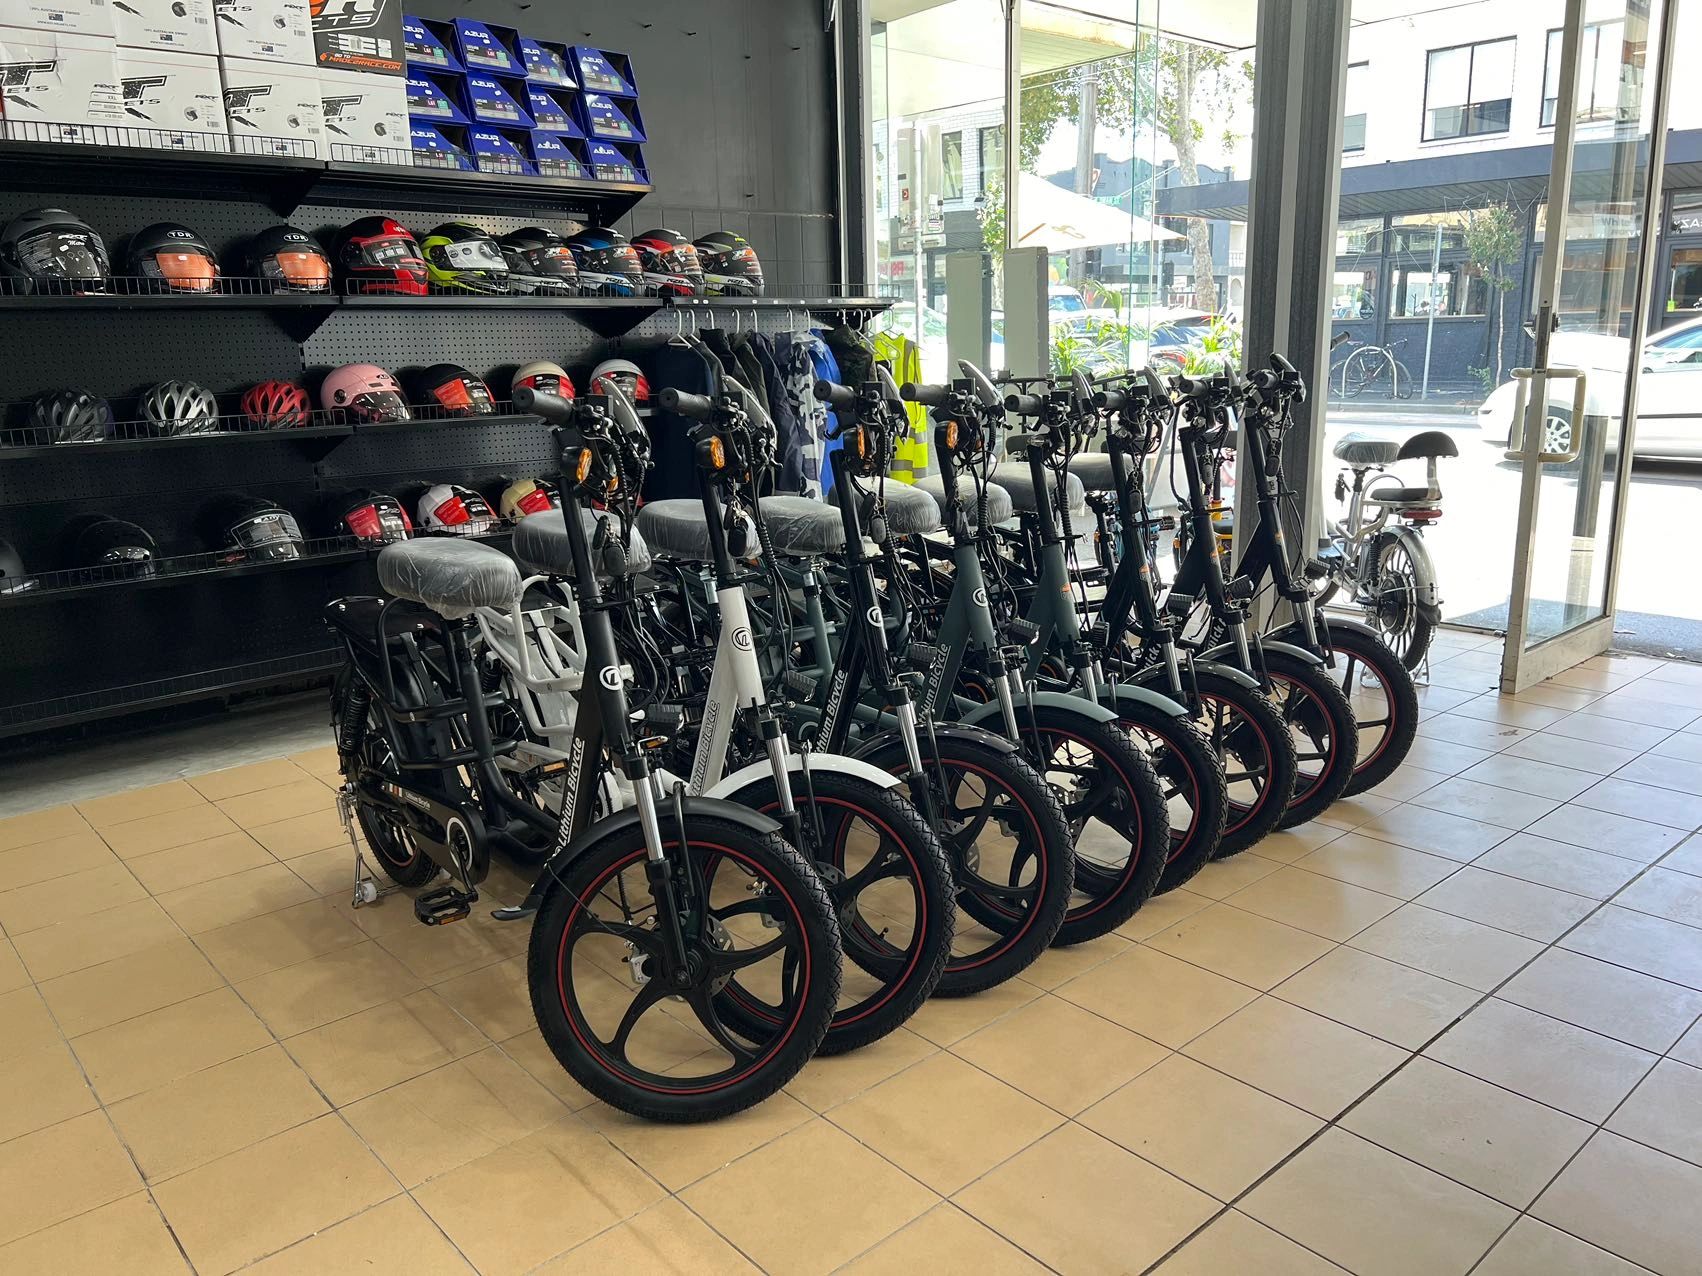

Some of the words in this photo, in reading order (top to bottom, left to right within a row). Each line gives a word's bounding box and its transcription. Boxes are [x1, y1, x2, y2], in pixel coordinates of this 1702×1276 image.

[464, 30, 489, 39] AZUR
[523, 47, 540, 55] ZUR
[582, 56, 604, 64] AZUR
[472, 80, 496, 89] AZUR
[530, 94, 546, 102] ZUR
[592, 102, 613, 110] AZUR
[411, 131, 437, 139] AZUR
[475, 133, 500, 141] AZUR
[172, 231, 193, 239] TDR
[287, 234, 307, 242] TDR
[928, 643, 948, 689] Bicycle
[826, 669, 846, 716] Bicycle
[691, 749, 709, 796] ithium
[701, 699, 719, 750] Bicycle
[558, 791, 574, 847] Lithium
[567, 737, 582, 792] Bicycle
